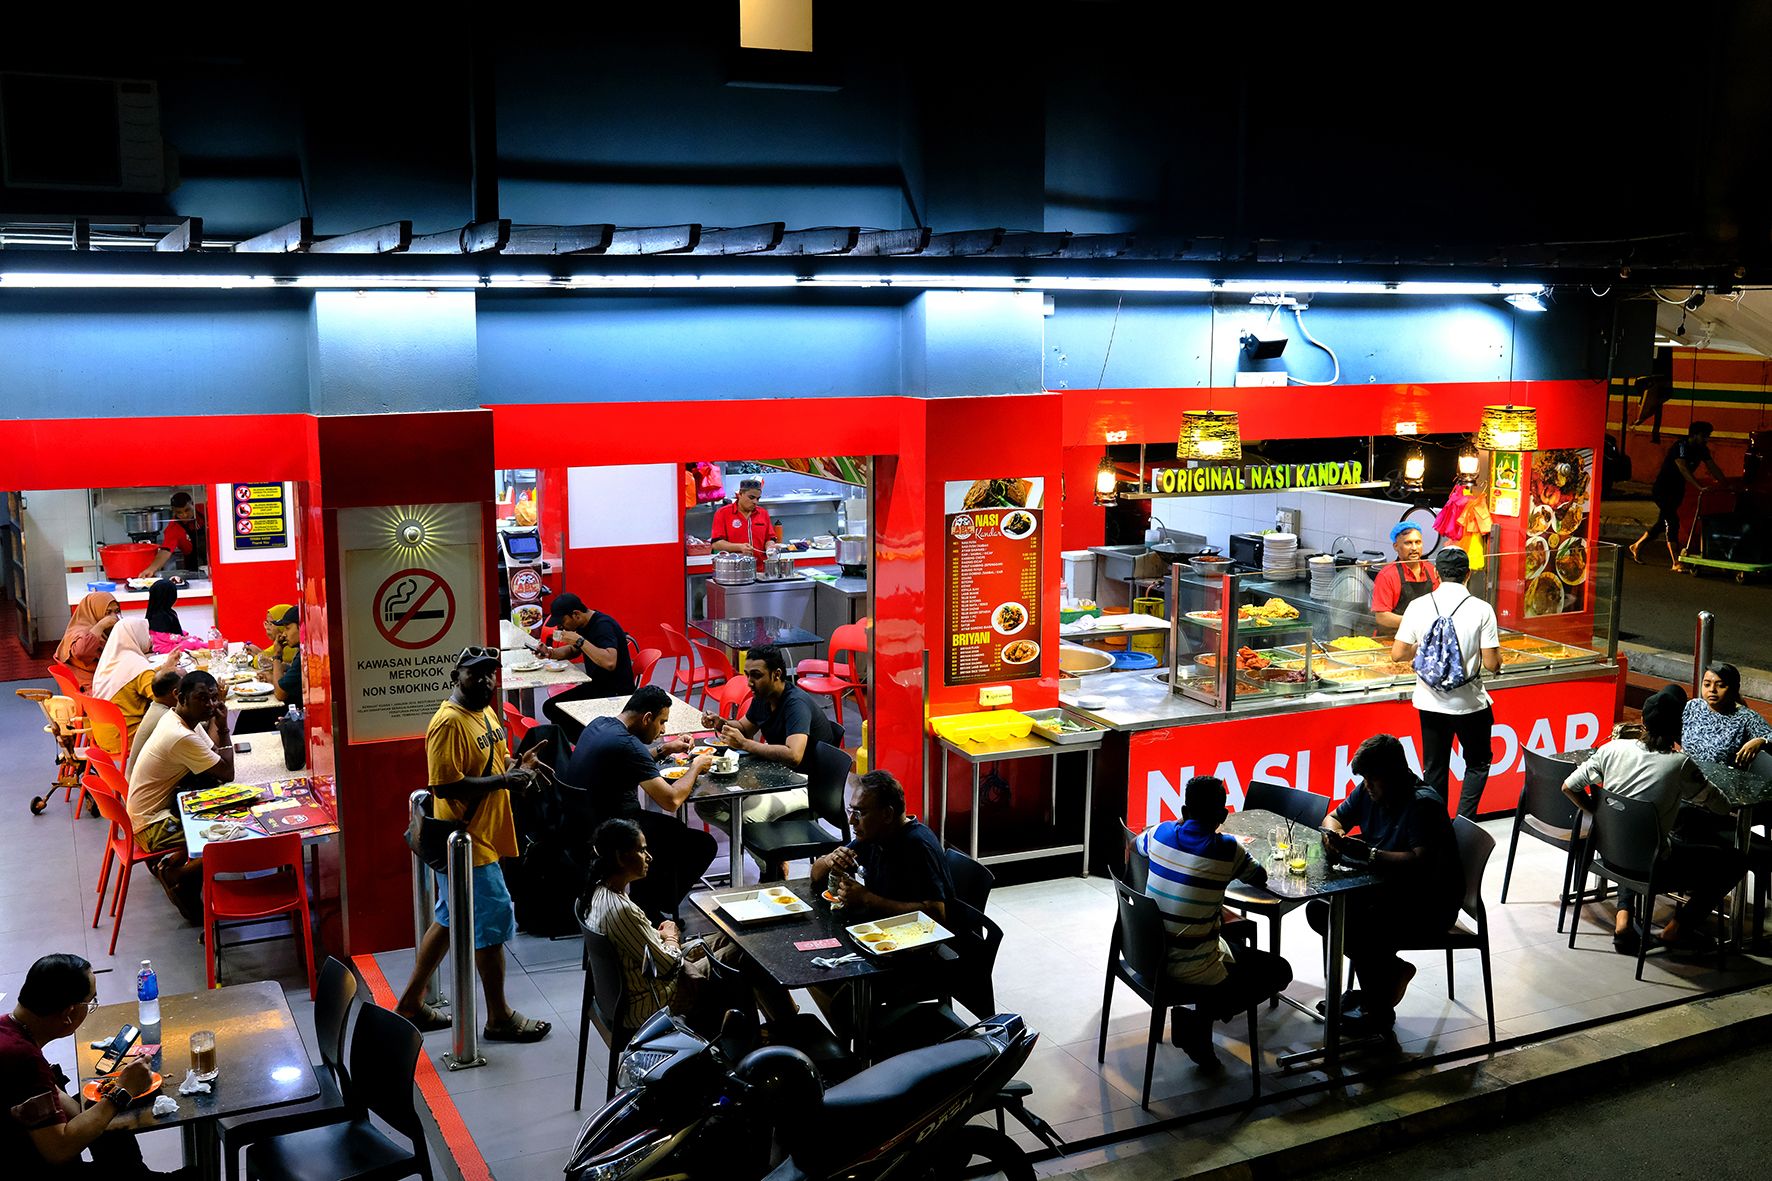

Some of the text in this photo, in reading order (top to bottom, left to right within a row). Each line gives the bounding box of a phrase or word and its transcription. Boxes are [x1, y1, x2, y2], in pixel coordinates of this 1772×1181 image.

[1162, 461, 1362, 494] ORIGINAL NASI KANDAR
[975, 513, 999, 528] NASI
[975, 527, 1002, 540] Kandar
[952, 632, 990, 647] BRIYANI
[357, 654, 458, 670] KAWASAN LARANG
[389, 667, 444, 680] MEROKOK
[363, 686, 386, 697] NON
[389, 682, 440, 695] SMOKING
[1146, 712, 1599, 830] NASI KDAR
